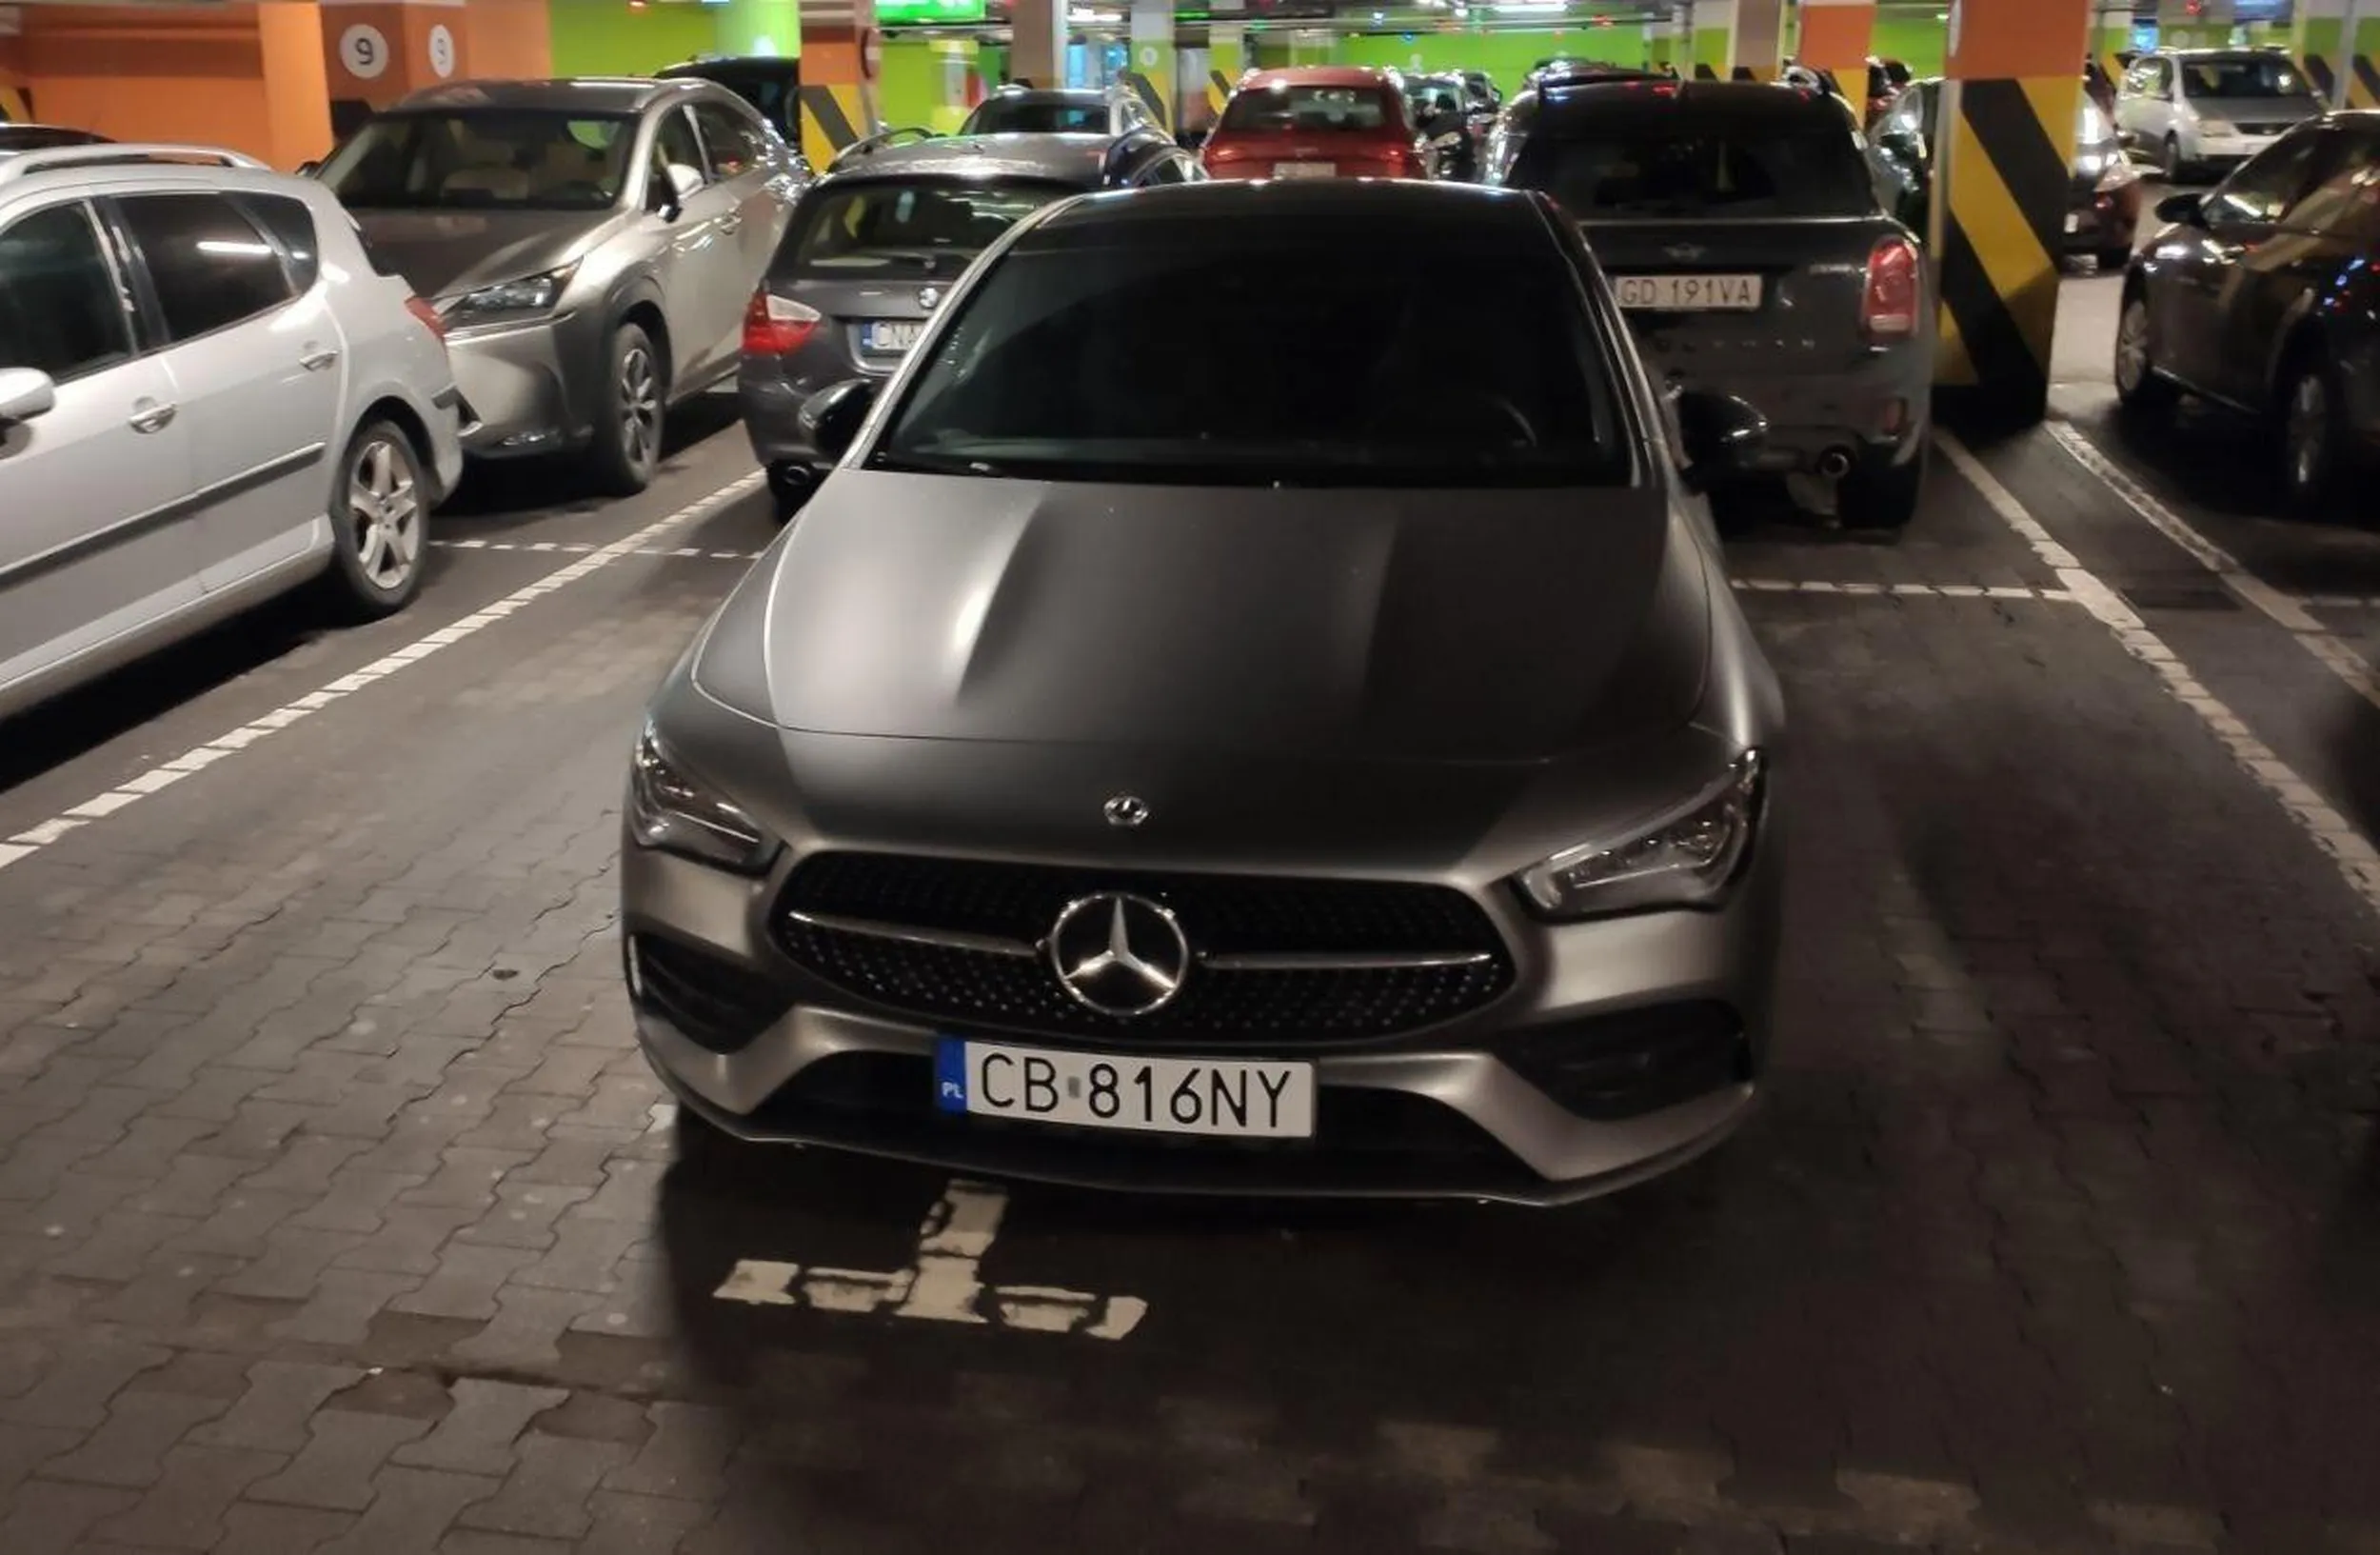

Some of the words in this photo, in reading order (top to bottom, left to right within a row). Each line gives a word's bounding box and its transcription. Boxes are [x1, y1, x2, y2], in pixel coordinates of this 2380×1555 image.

[354, 37, 374, 66] 9
[1621, 279, 1656, 305] GD
[1671, 279, 1752, 304] 191VA
[942, 1081, 964, 1099] PL
[981, 1052, 1059, 1112] CB
[1089, 1063, 1291, 1127] 816NY
